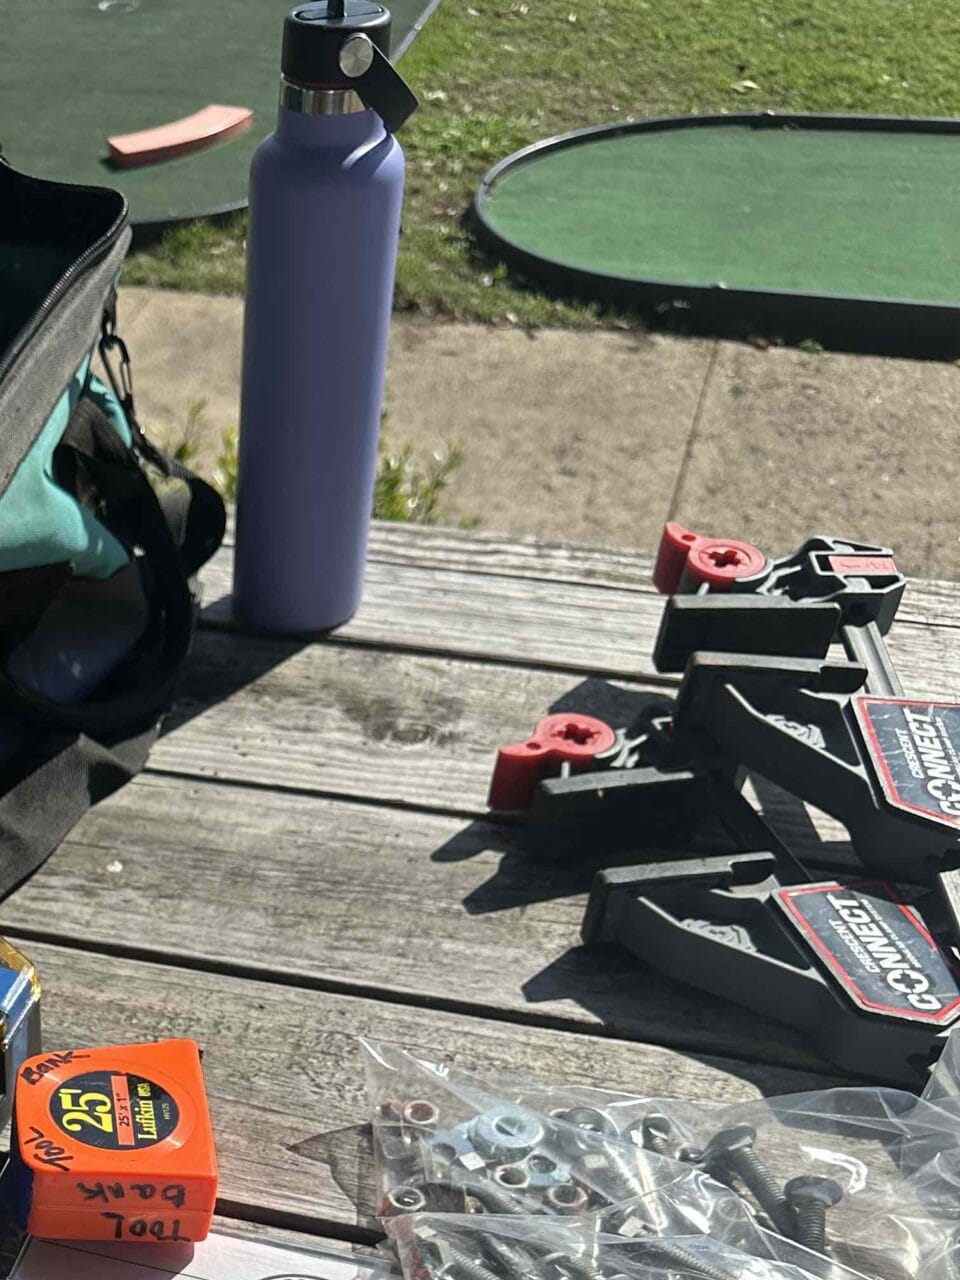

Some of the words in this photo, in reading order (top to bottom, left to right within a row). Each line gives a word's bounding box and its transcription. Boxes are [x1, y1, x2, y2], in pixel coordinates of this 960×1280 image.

[895, 727, 924, 779] CRESCENT
[826, 892, 942, 1010] CONNECT
[828, 919, 881, 973] CRESCENT
[118, 1112, 130, 1128] 25'
[134, 1100, 158, 1140] Lufkin
